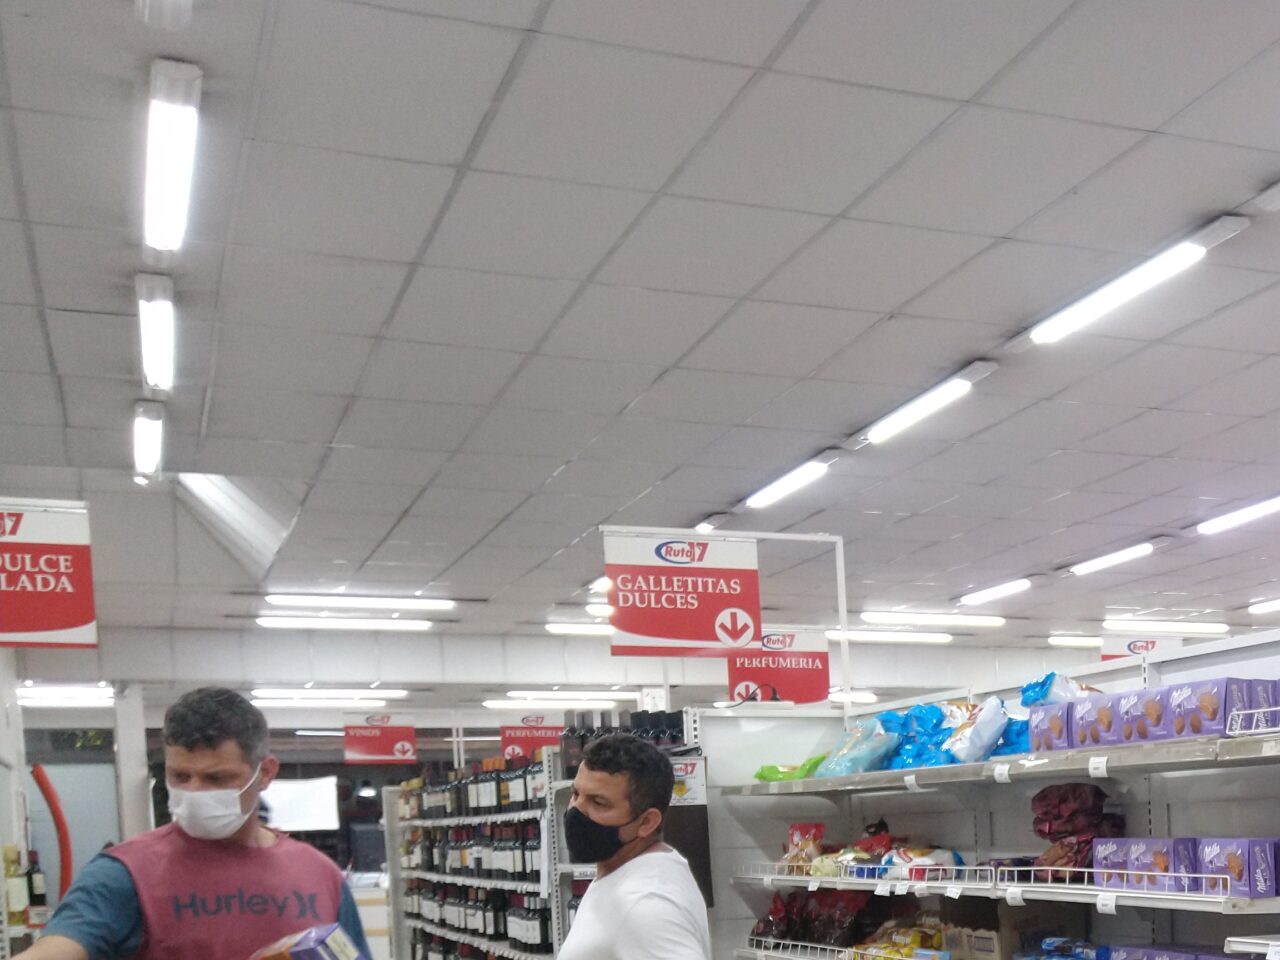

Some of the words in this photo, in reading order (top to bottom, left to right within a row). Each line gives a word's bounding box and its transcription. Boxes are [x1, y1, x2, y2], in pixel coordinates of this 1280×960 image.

[0, 553, 74, 573] ULCE
[617, 574, 741, 595] GALLETITAS
[618, 592, 699, 610] DULCES
[736, 657, 822, 669] PERFUMERIA
[1170, 686, 1192, 706] Milka
[1203, 842, 1220, 862] Milka
[172, 888, 290, 921] Hurley
